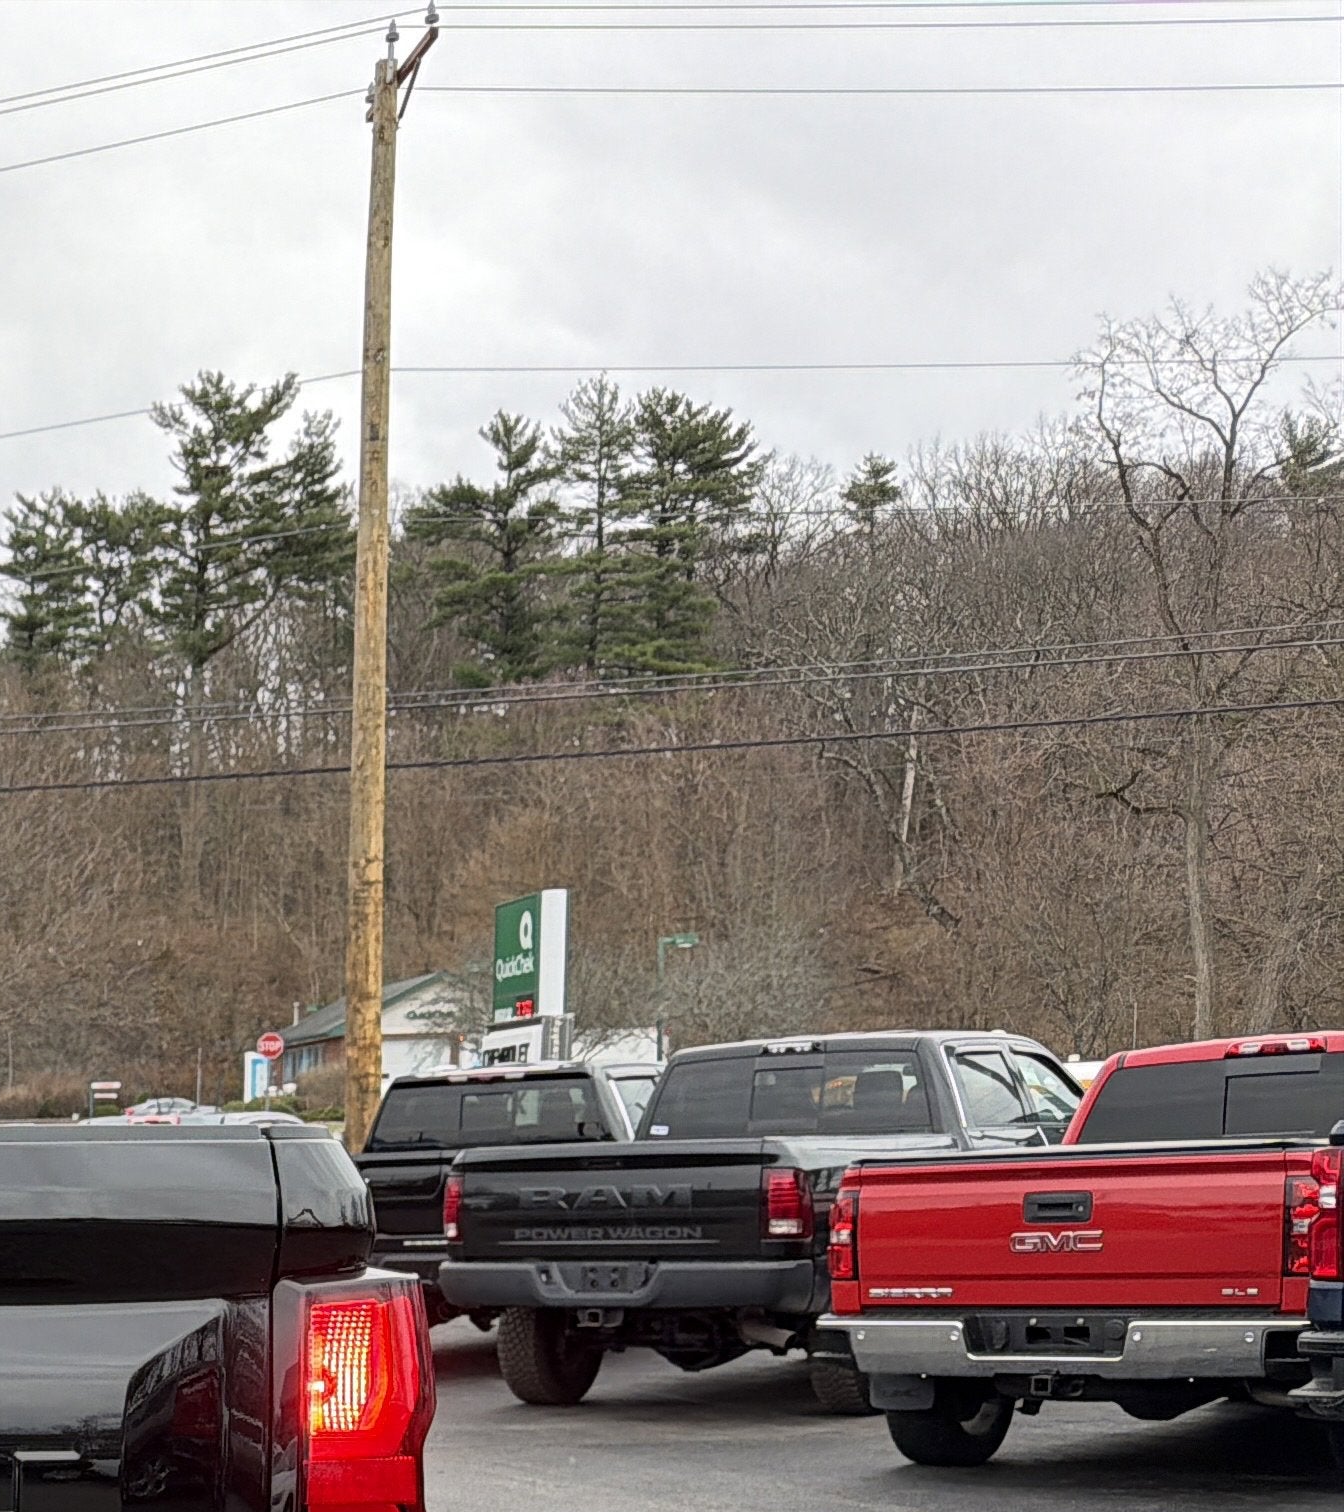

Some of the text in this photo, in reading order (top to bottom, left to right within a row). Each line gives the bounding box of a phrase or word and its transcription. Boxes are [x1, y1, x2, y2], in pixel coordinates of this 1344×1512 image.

[260, 1041, 283, 1052] STOP
[519, 1184, 693, 1210] RAM
[514, 1226, 702, 1240] POWER WAGON
[1009, 1229, 1103, 1253] GMC
[869, 1287, 953, 1298] SIERRA
